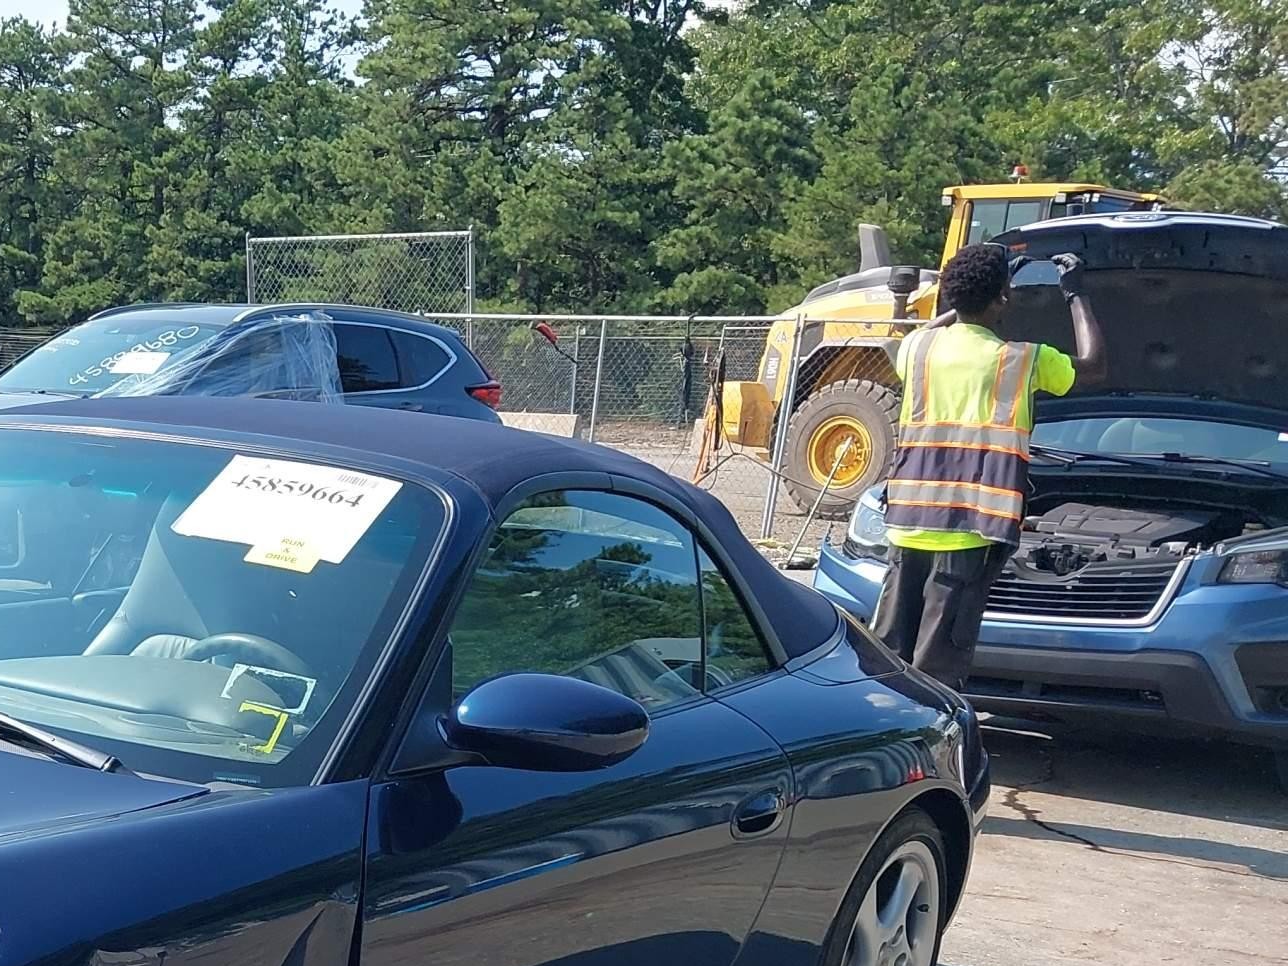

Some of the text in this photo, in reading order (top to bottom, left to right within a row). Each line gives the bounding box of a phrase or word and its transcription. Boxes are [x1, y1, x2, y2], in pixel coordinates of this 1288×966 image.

[231, 474, 365, 508] 45859664
[281, 537, 306, 548] RUN
[265, 552, 298, 564] DRIVE
